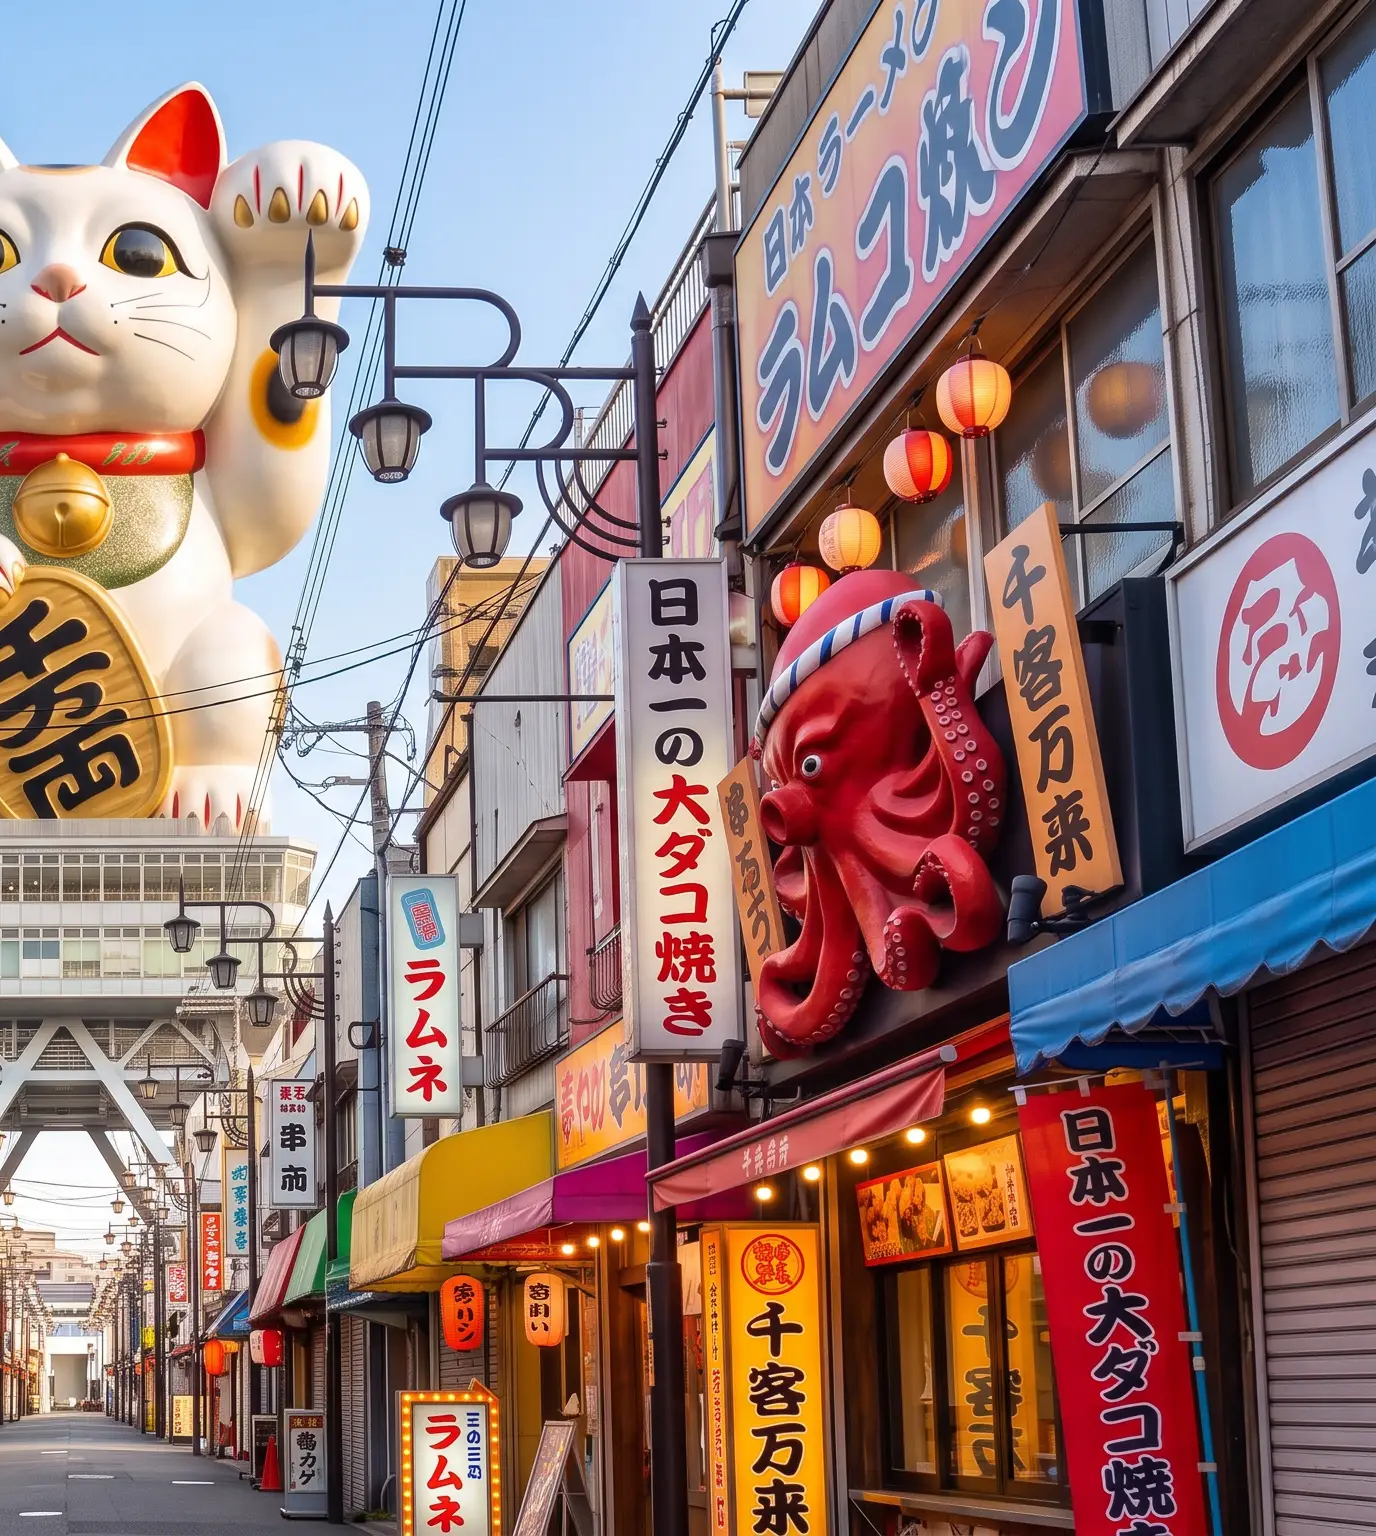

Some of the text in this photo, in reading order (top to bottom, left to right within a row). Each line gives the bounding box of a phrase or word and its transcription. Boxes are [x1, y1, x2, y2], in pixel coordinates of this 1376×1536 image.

[647, 578, 717, 1037] 日本一の大ダコ焼き
[1002, 544, 1094, 877] 千客万来
[404, 959, 448, 1102] ラムネ
[746, 1301, 810, 1536] 千客万来
[1061, 1106, 1177, 1536] 日本一の大ダコ焼
[425, 1414, 465, 1533] ラムネ
